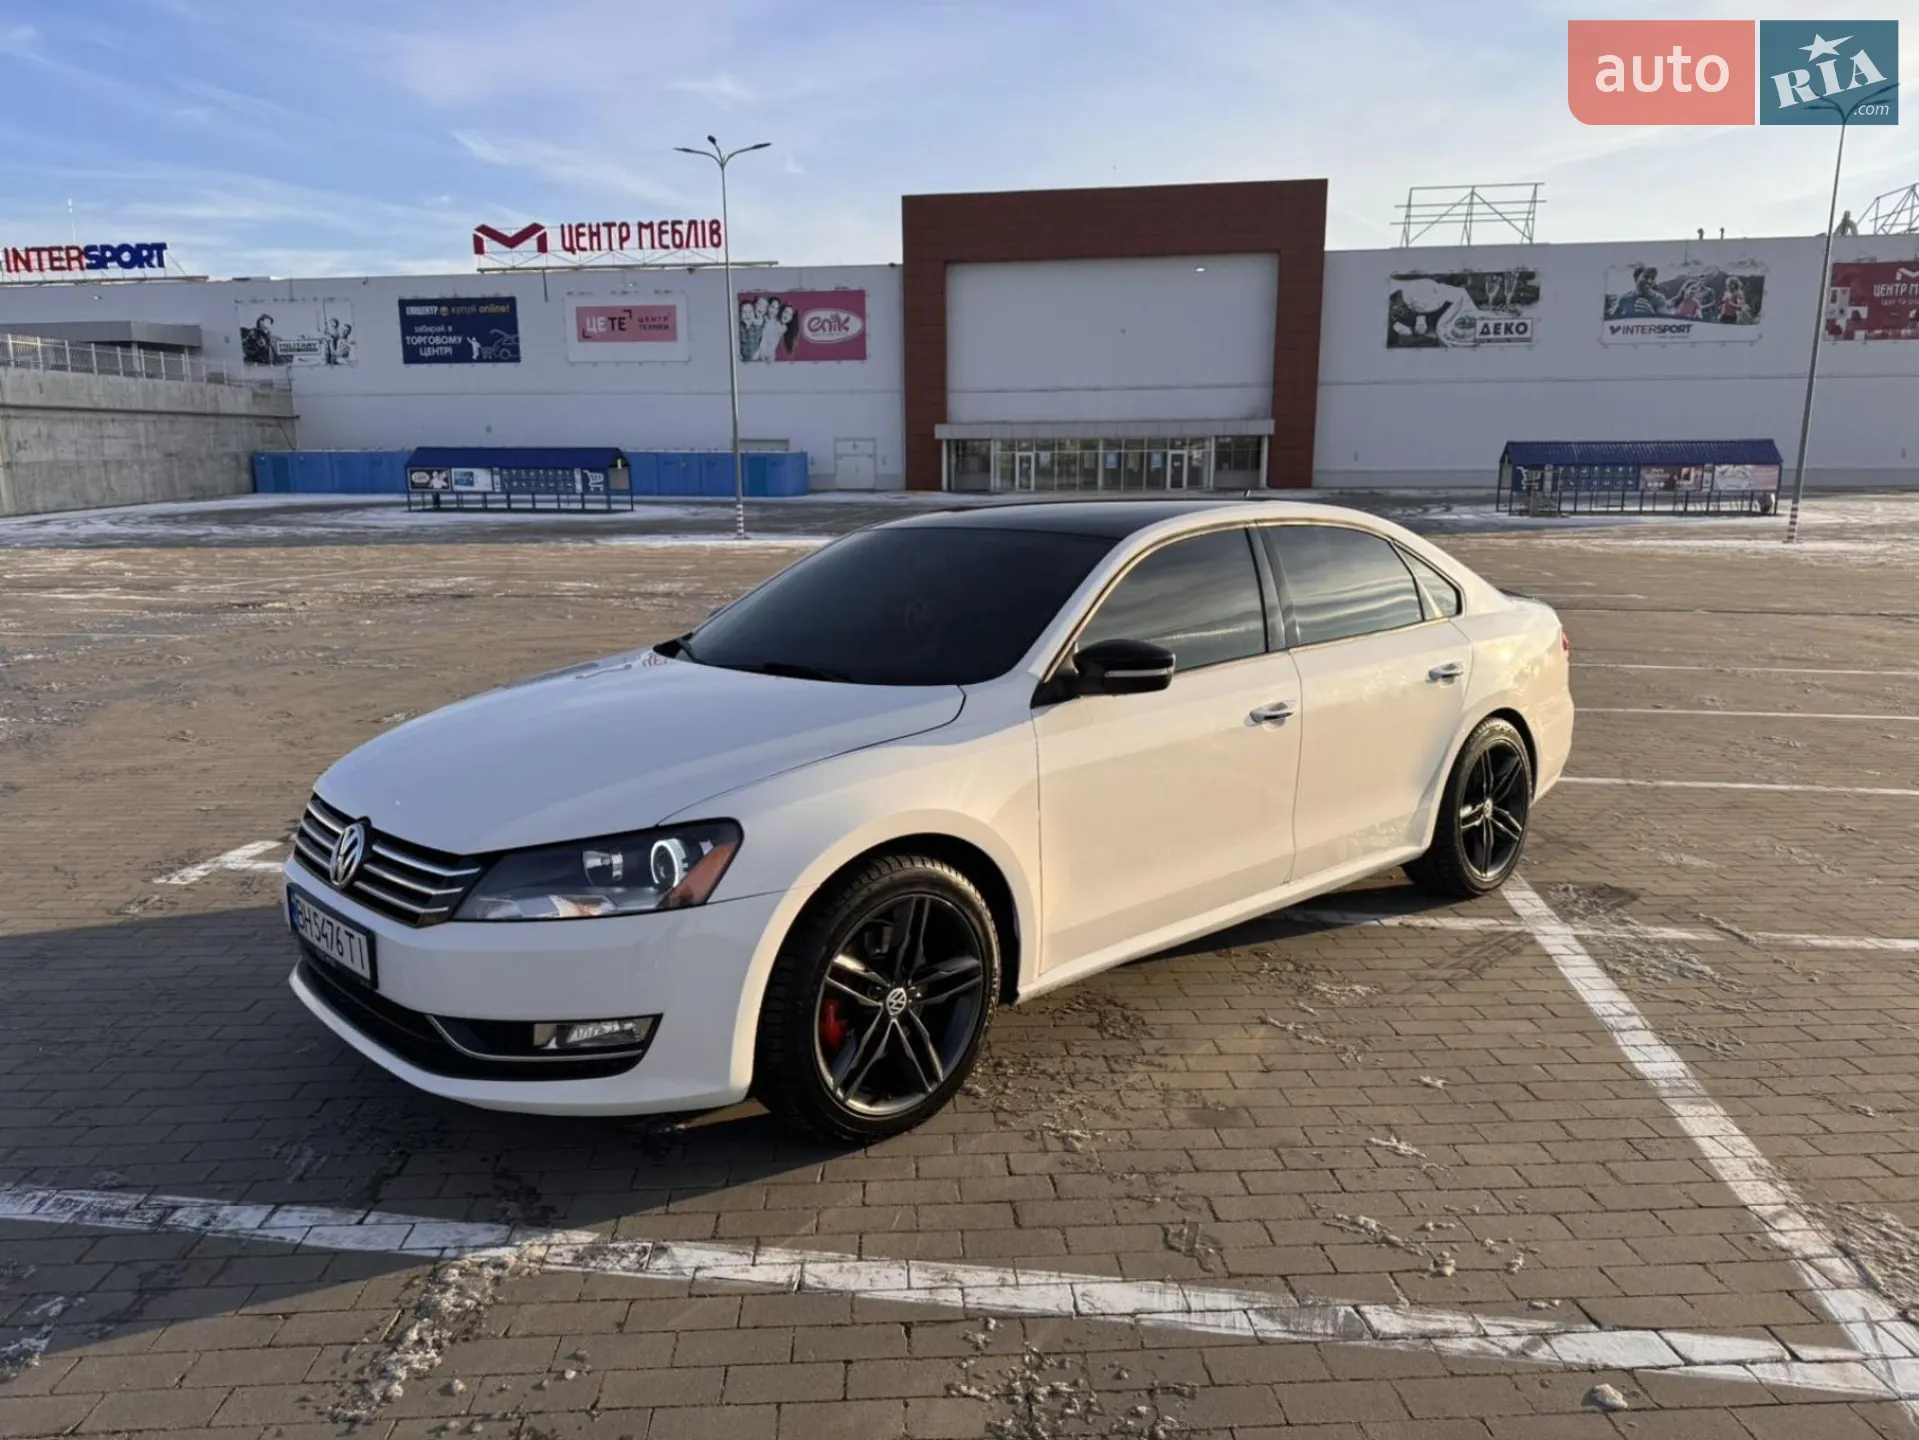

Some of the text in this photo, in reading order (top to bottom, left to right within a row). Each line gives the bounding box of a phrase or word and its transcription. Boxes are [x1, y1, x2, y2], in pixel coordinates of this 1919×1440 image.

[560, 221, 631, 254] ЦЕНТР
[637, 218, 723, 250] МЕБЛІВ
[5, 242, 168, 273] INTERSPORT
[586, 316, 627, 334] ЦЕТЕ
[1621, 323, 1694, 335] INTERSPORT
[405, 335, 463, 345] ТОРГОВОМУ
